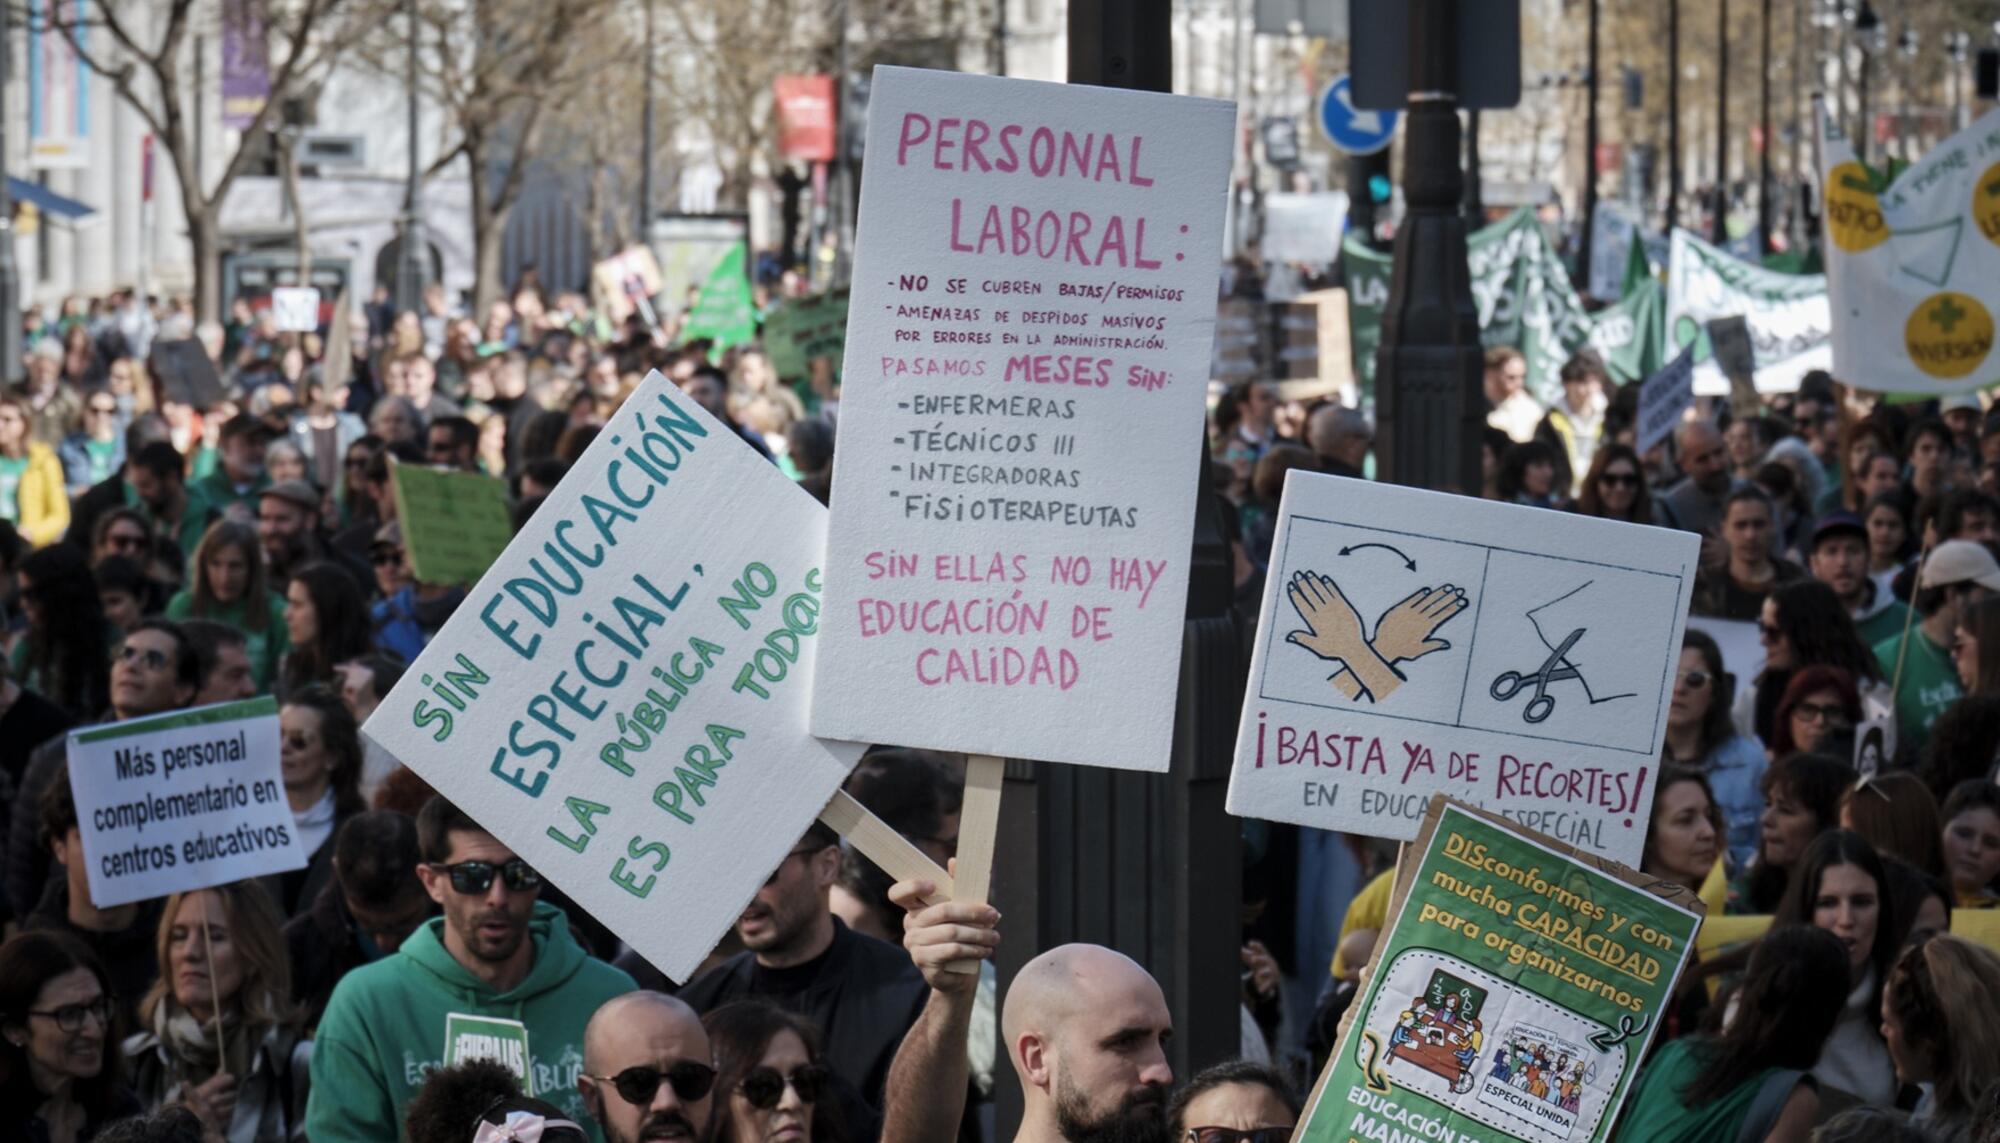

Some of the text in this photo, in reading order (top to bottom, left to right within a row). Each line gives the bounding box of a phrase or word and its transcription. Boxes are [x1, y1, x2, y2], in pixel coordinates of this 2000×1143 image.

[897, 112, 1155, 188] PERSONAL
[950, 198, 1189, 270] LABORAL:
[945, 278, 968, 294] SE
[981, 279, 1042, 295] CUBREN
[1058, 281, 1185, 304] BAJAS/PERMISOS
[994, 310, 1011, 323] DE
[1021, 309, 1089, 326] DESPIDOS
[1101, 314, 1167, 331] MASIVOS
[894, 329, 1169, 351] POR ERRORES EN LA ADMINISTRACIÓN.
[881, 354, 1174, 392] PASAMOS MESES SIN:
[412, 652, 491, 743] SIN
[479, 393, 709, 661] EDUCACIÓN
[864, 549, 1168, 609] SIN ELLAS NO HAY
[857, 589, 1113, 642] EDUCACIÓN DE
[489, 562, 706, 800] ESPECIAL,
[916, 645, 1080, 691] CALIDAD
[546, 561, 779, 854] LA PÚBLICA NO
[114, 729, 247, 782] Más personal
[1254, 711, 1648, 829] ¡BASTA YA DE RECORTES!
[93, 778, 279, 833] complementario en
[608, 835, 672, 899] ES
[651, 722, 747, 825] PARA
[1302, 780, 1339, 808] EN
[101, 822, 291, 880] centros educativos
[1442, 831, 1674, 951] DISconformes y con
[1432, 869, 1662, 982] mucha CAPACIDAD
[1418, 902, 1644, 1012] para organizarnos
[1347, 1085, 1456, 1143] EDUCACIÓN
[1484, 1083, 1572, 1130] ESPECIAL UNIDA
